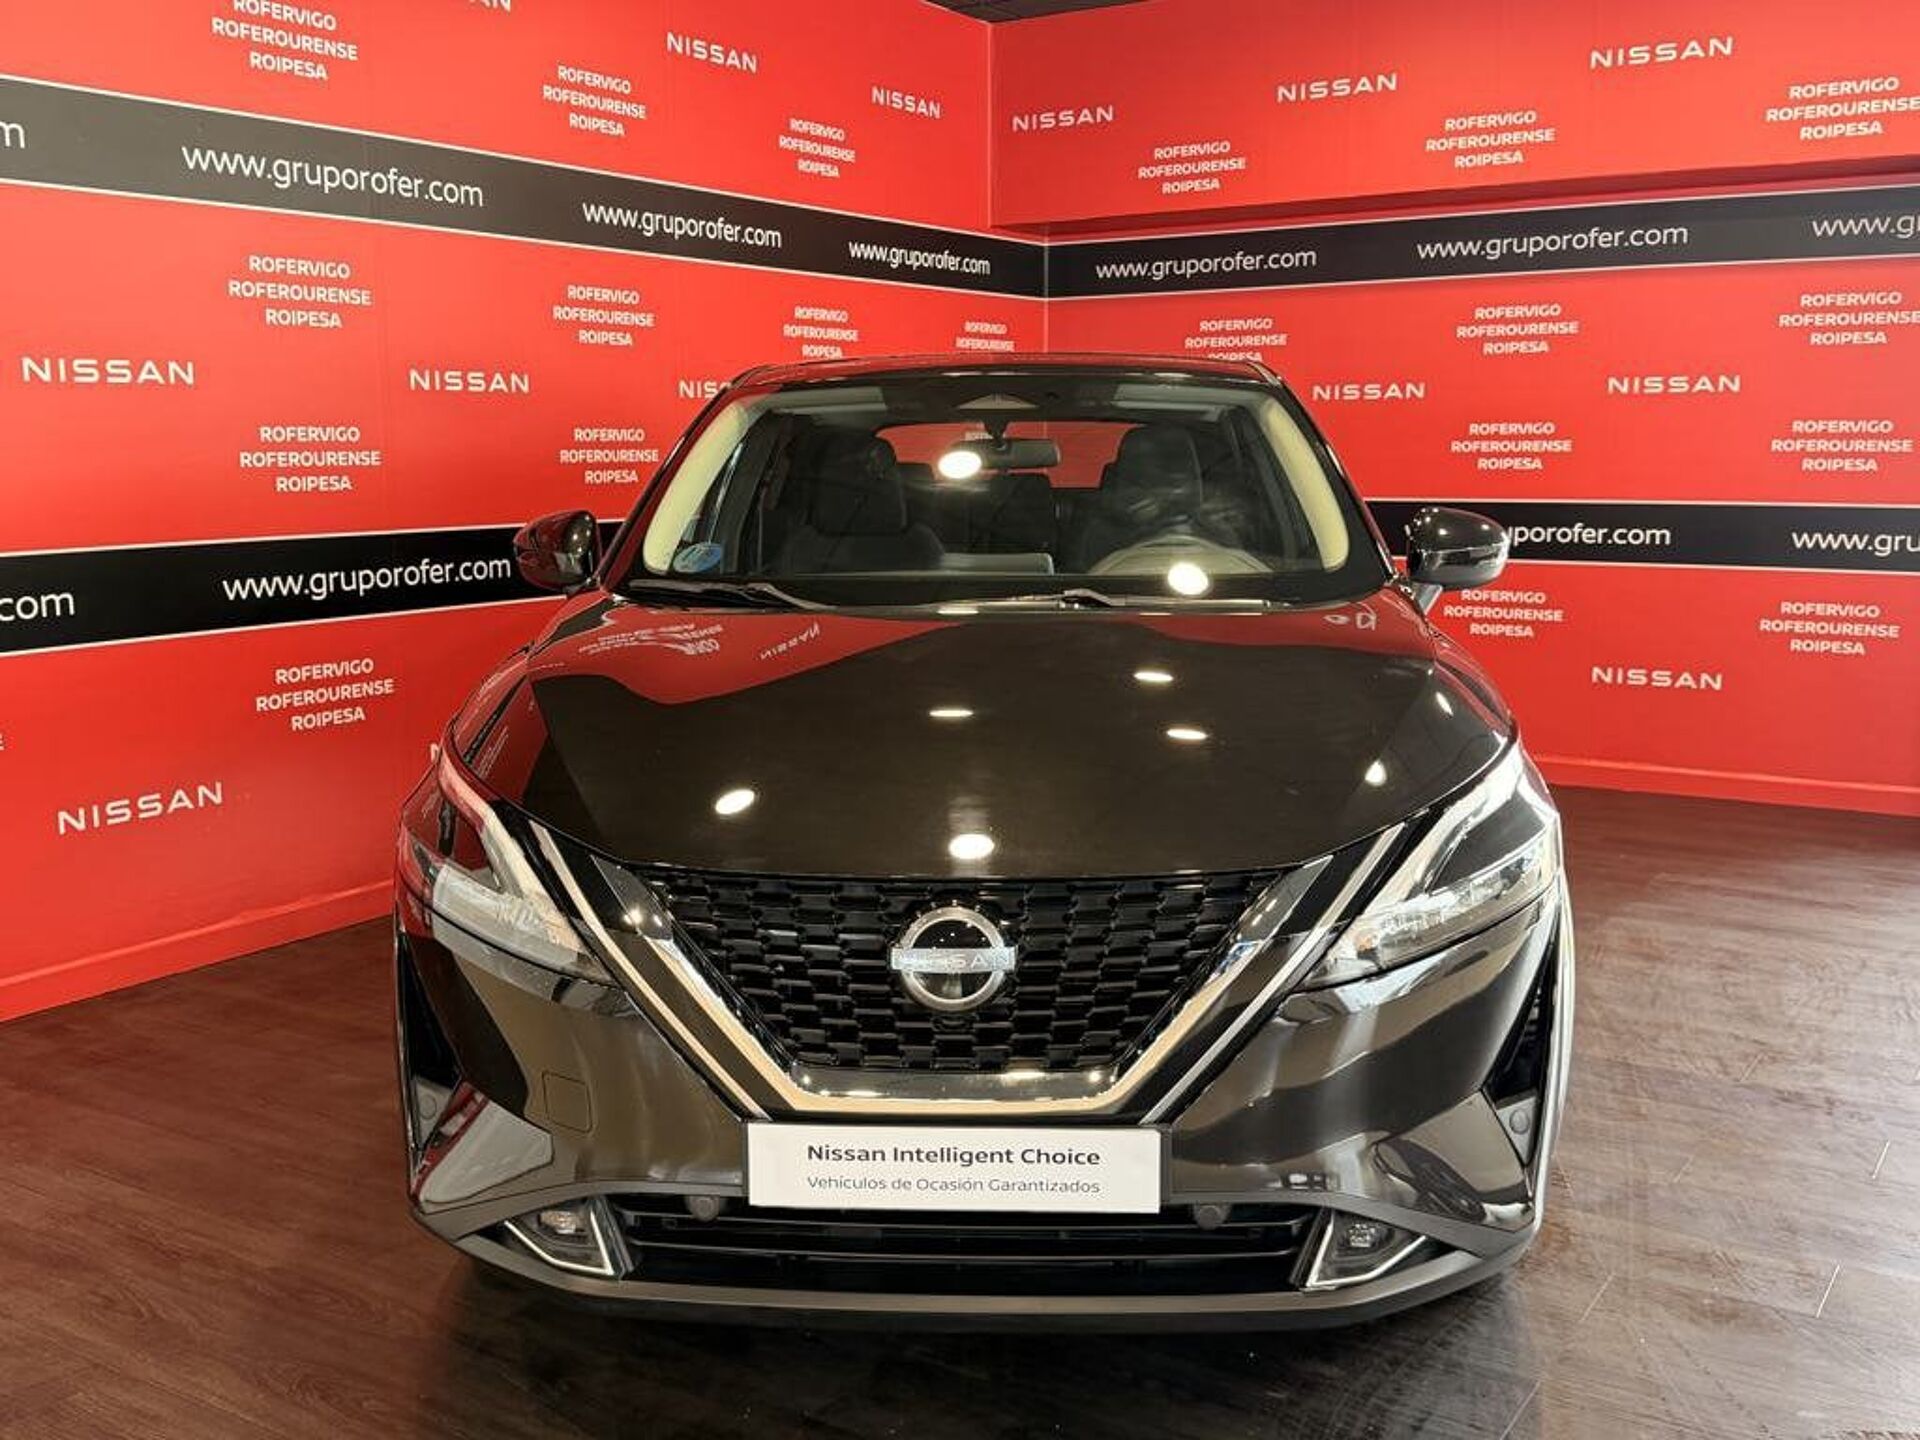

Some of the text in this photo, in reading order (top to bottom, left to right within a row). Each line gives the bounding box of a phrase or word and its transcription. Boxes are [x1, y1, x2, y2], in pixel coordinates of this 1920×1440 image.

[211, 17, 358, 61] ROFEROURENSE
[666, 32, 757, 73] NISSAN
[1590, 36, 1733, 68] NISSAN
[249, 51, 327, 80] ROIPESA
[557, 65, 631, 95] ROFERVIGO
[1277, 73, 1397, 102] NISSAN
[1789, 76, 1900, 99] ROFERVIGO
[542, 84, 646, 119] ROFEROURENSE
[872, 87, 941, 119] NISSAN
[1766, 95, 1920, 122] ROFEROURENSE
[569, 112, 625, 136] ROIPESA
[1012, 105, 1114, 131] NISSAN
[1445, 110, 1537, 131] ROFERVIGO
[789, 118, 845, 142] ROFERVIGO
[1426, 128, 1555, 151] ROFEROURENSE
[1799, 120, 1883, 140] ROIPESA
[778, 135, 856, 163] ROFEROURENSE
[1154, 140, 1231, 160] ROFERVIGO
[1454, 150, 1524, 168] ROIPESA
[181, 146, 483, 207] www.gruporofer.com
[797, 158, 839, 177] ROIPESA
[1138, 157, 1246, 178] ROFEROURENSE
[1162, 177, 1220, 194] ROIPESA
[582, 202, 782, 248] www.gruporofer.com
[1812, 215, 1920, 239] www.g
[1416, 226, 1689, 260] www.gruporofer.com
[248, 255, 351, 279] ROFERVIGO
[848, 241, 991, 275] www.gruporofer.com
[1095, 250, 1317, 281] www.gruporofer.com
[228, 279, 371, 305] ROFEROURENSE
[567, 284, 640, 305] ROFERVIGO
[1800, 291, 1903, 307] ROFERVIGO
[265, 308, 342, 328] ROIPESA
[552, 305, 654, 327] ROFEROURENSE
[794, 306, 848, 323] ROFERVIGO
[1474, 303, 1562, 320] ROFERVIGO
[1779, 310, 1920, 327] ROFEROURENSE
[1199, 317, 1273, 332] ROFERVIGO
[1456, 321, 1579, 338] ROFEROURENSE
[578, 329, 633, 346] ROIPESA
[1184, 333, 1287, 349] ROFEROURENSE
[1483, 340, 1549, 355] ROIPESA
[1810, 331, 1887, 346] ROIPESA
[21, 356, 194, 385] NISSAN
[409, 369, 529, 393] NISSAN
[1608, 375, 1741, 394] NISSAN
[1312, 382, 1425, 401] NISSAN
[259, 425, 361, 443] ROFERVIGO
[573, 427, 645, 442] ROFERVIGO
[1469, 422, 1556, 435] ROFERVIGO
[1792, 419, 1894, 434] ROFERVIGO
[1450, 439, 1572, 453] ROFEROURENSE
[1771, 438, 1913, 453] ROFEROURENSE
[239, 450, 381, 468] ROFEROURENSE
[559, 448, 660, 464] ROFEROURENSE
[1477, 456, 1543, 470] ROIPESA
[1801, 457, 1878, 472] ROIPESA
[276, 475, 353, 492] ROIPESA
[584, 469, 639, 484] ROIPESA
[222, 558, 511, 601] www.gruporofer.com
[1460, 588, 1546, 604] ROFERVIGO
[1443, 605, 1563, 622] ROFEROURENSE
[1780, 601, 1881, 618] ROFERVIGO
[1469, 622, 1534, 637] ROIPESA
[1759, 618, 1901, 638] ROFEROURENSE
[1790, 638, 1865, 656] ROIPESA
[275, 658, 374, 685] ROFERVIGO
[1591, 666, 1722, 691] NISSAN
[255, 678, 394, 712] ROFEROURENSE
[291, 706, 366, 731] ROIPESA
[57, 782, 223, 835] NISSAN
[807, 1144, 1101, 1167] Nissan Intelligent Choice
[891, 1178, 912, 1190] de
[916, 1177, 984, 1192] Ocasión
[988, 1179, 1101, 1193] Garantizados
